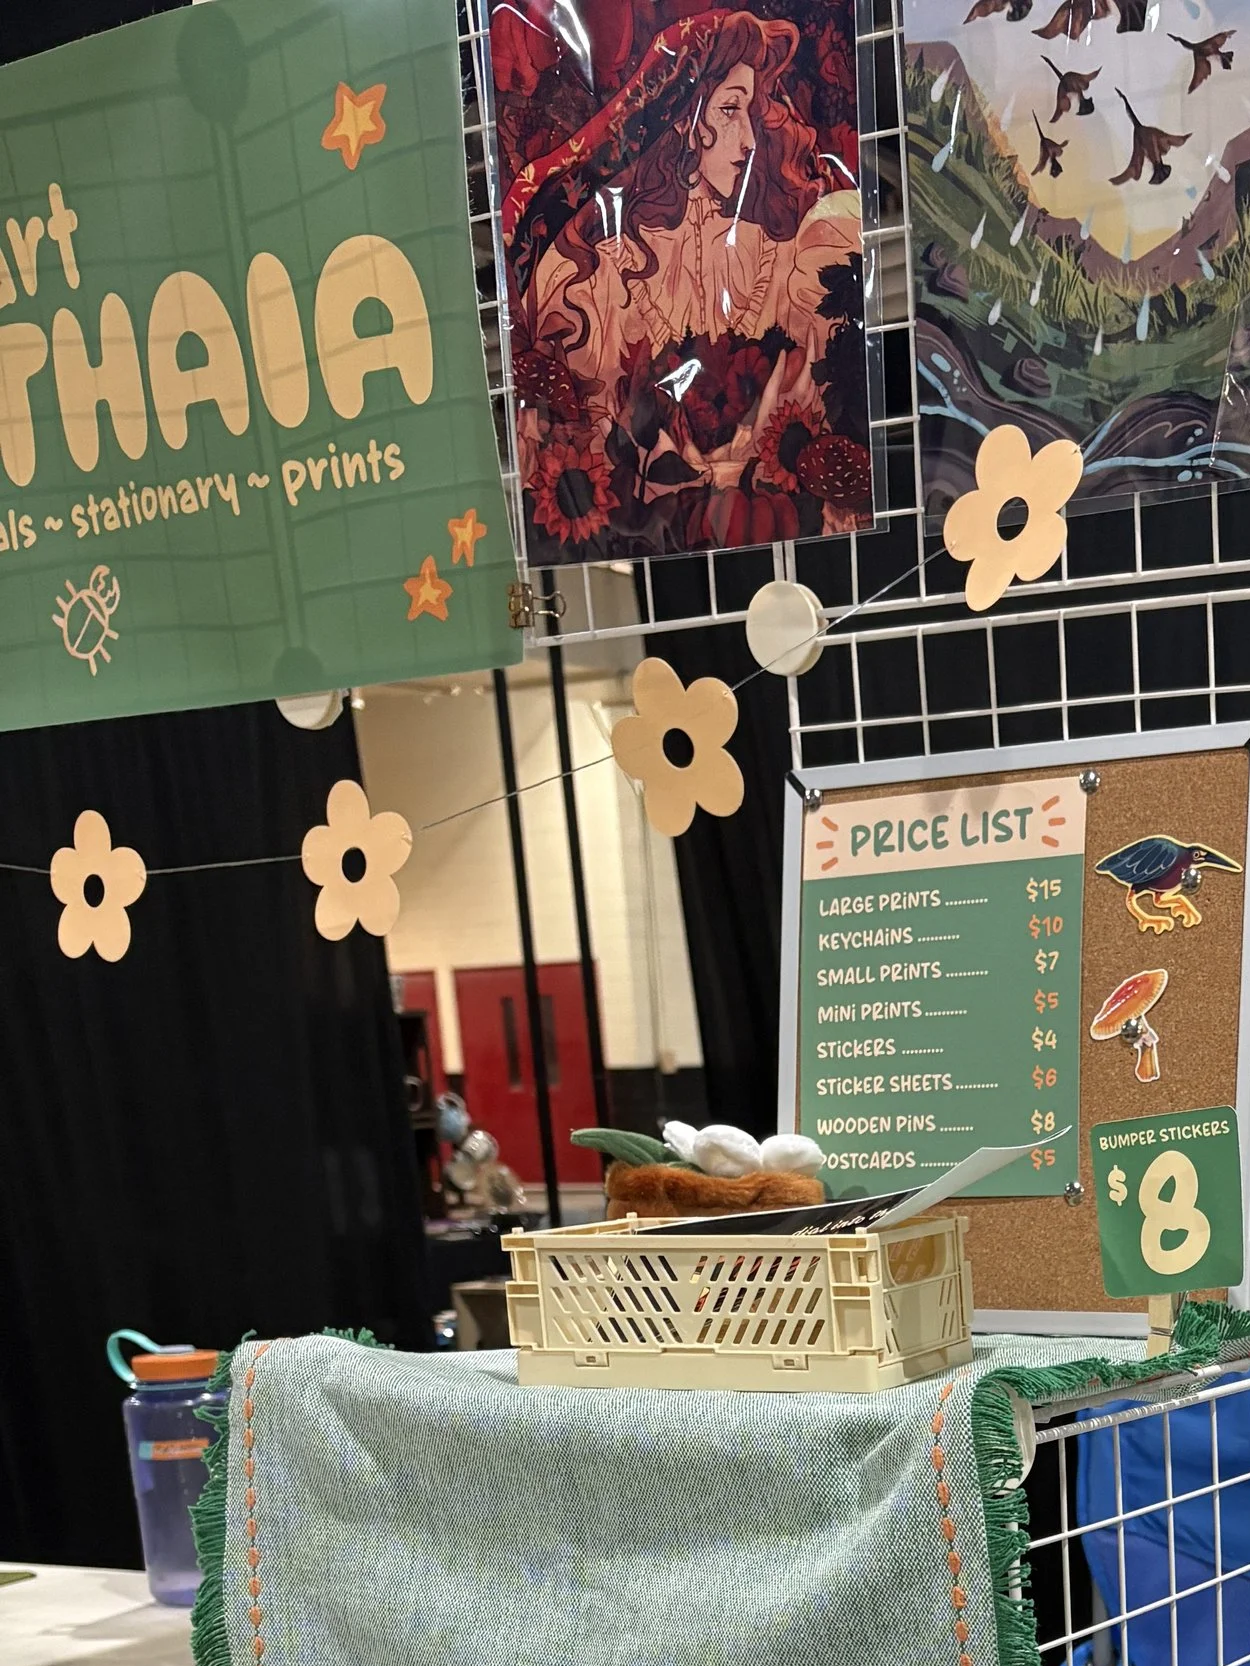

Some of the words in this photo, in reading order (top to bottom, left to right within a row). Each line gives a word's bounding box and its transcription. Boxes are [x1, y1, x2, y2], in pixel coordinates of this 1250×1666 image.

[71, 473, 240, 538] stationary
[281, 439, 405, 506] prints
[850, 815, 949, 857] PRICE
[961, 807, 1033, 846] LIST
[819, 895, 875, 917] LARGE
[1026, 877, 1062, 903] $15
[1027, 916, 1063, 940] $10
[817, 967, 876, 987] SMALL
[1034, 949, 1060, 974] $7
[1033, 989, 1059, 1014] $5
[1031, 1027, 1058, 1051] $4
[889, 1073, 954, 1092] SHEETS
[1031, 1065, 1057, 1090] $6
[816, 1116, 892, 1136] WOODEN
[1030, 1109, 1056, 1134] $8
[1099, 1129, 1156, 1150] BUMPER
[1158, 1120, 1231, 1142] STICKERS
[1030, 1147, 1056, 1171] $5
